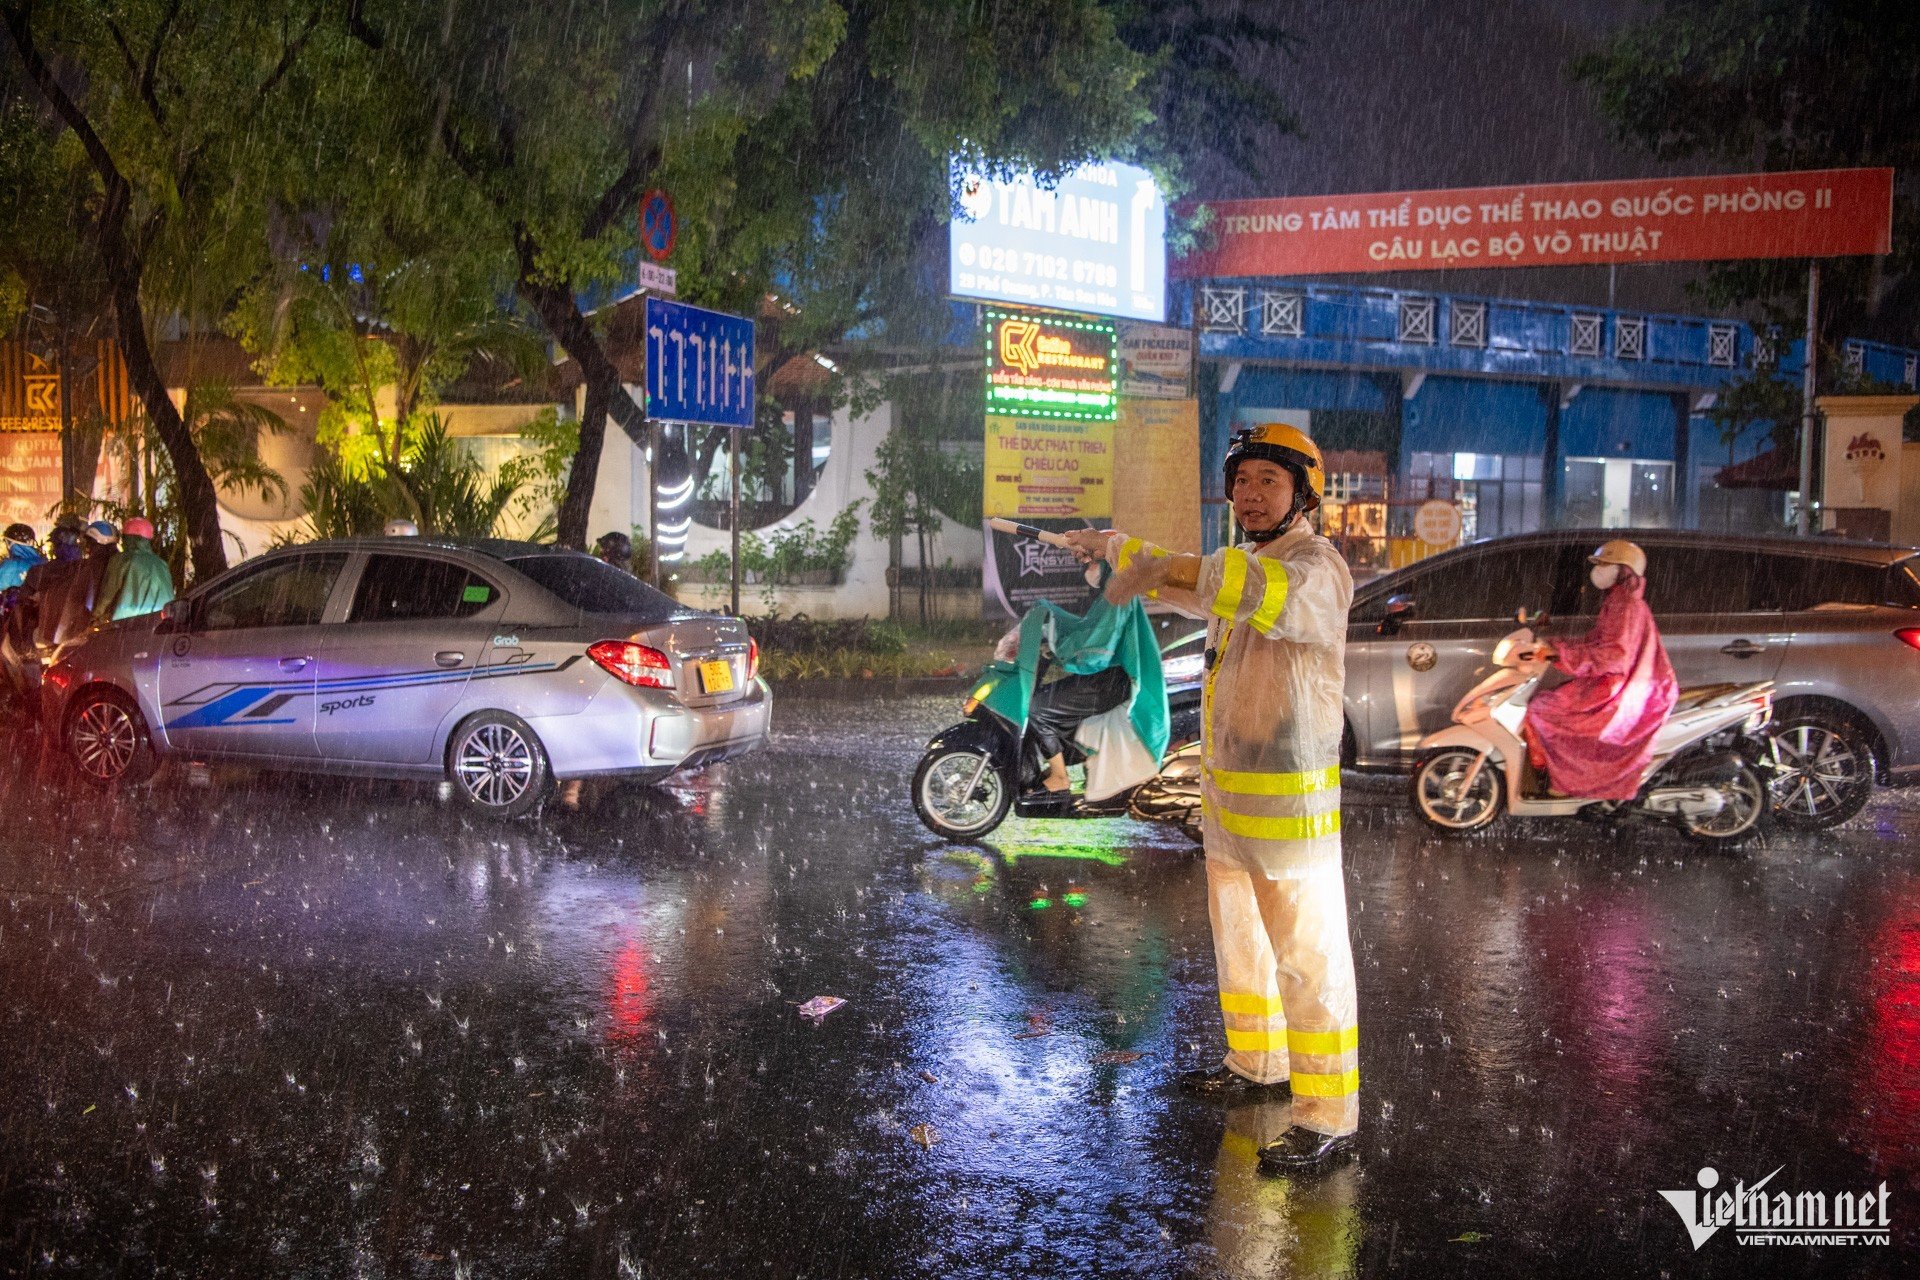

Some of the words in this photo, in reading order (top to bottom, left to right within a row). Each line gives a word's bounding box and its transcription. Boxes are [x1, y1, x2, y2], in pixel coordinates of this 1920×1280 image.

[994, 174, 1056, 233] TÂM
[1059, 194, 1118, 244] ANH
[1224, 213, 1303, 234] TRUNG
[1309, 207, 1361, 231] TÂM
[1367, 198, 1412, 228] THỂ
[1417, 205, 1472, 231] DỤC
[1479, 193, 1526, 222] THỂ
[1530, 199, 1602, 220] THAO
[1610, 188, 1695, 218] QUỐC
[1703, 187, 1806, 214] PHÒNG
[1815, 188, 1832, 209] II
[1368, 236, 1423, 260] CÂU
[1430, 237, 1480, 263] LẠC
[1488, 231, 1525, 261] BỘ
[1532, 228, 1572, 254] VÕ
[1579, 226, 1663, 257] THUẬT
[1022, 251, 1068, 281] 7102
[1037, 352, 1106, 370] RESTAURANT
[1056, 459, 1079, 471] CAO
[493, 635, 520, 646] Grab
[319, 695, 376, 715] sports
